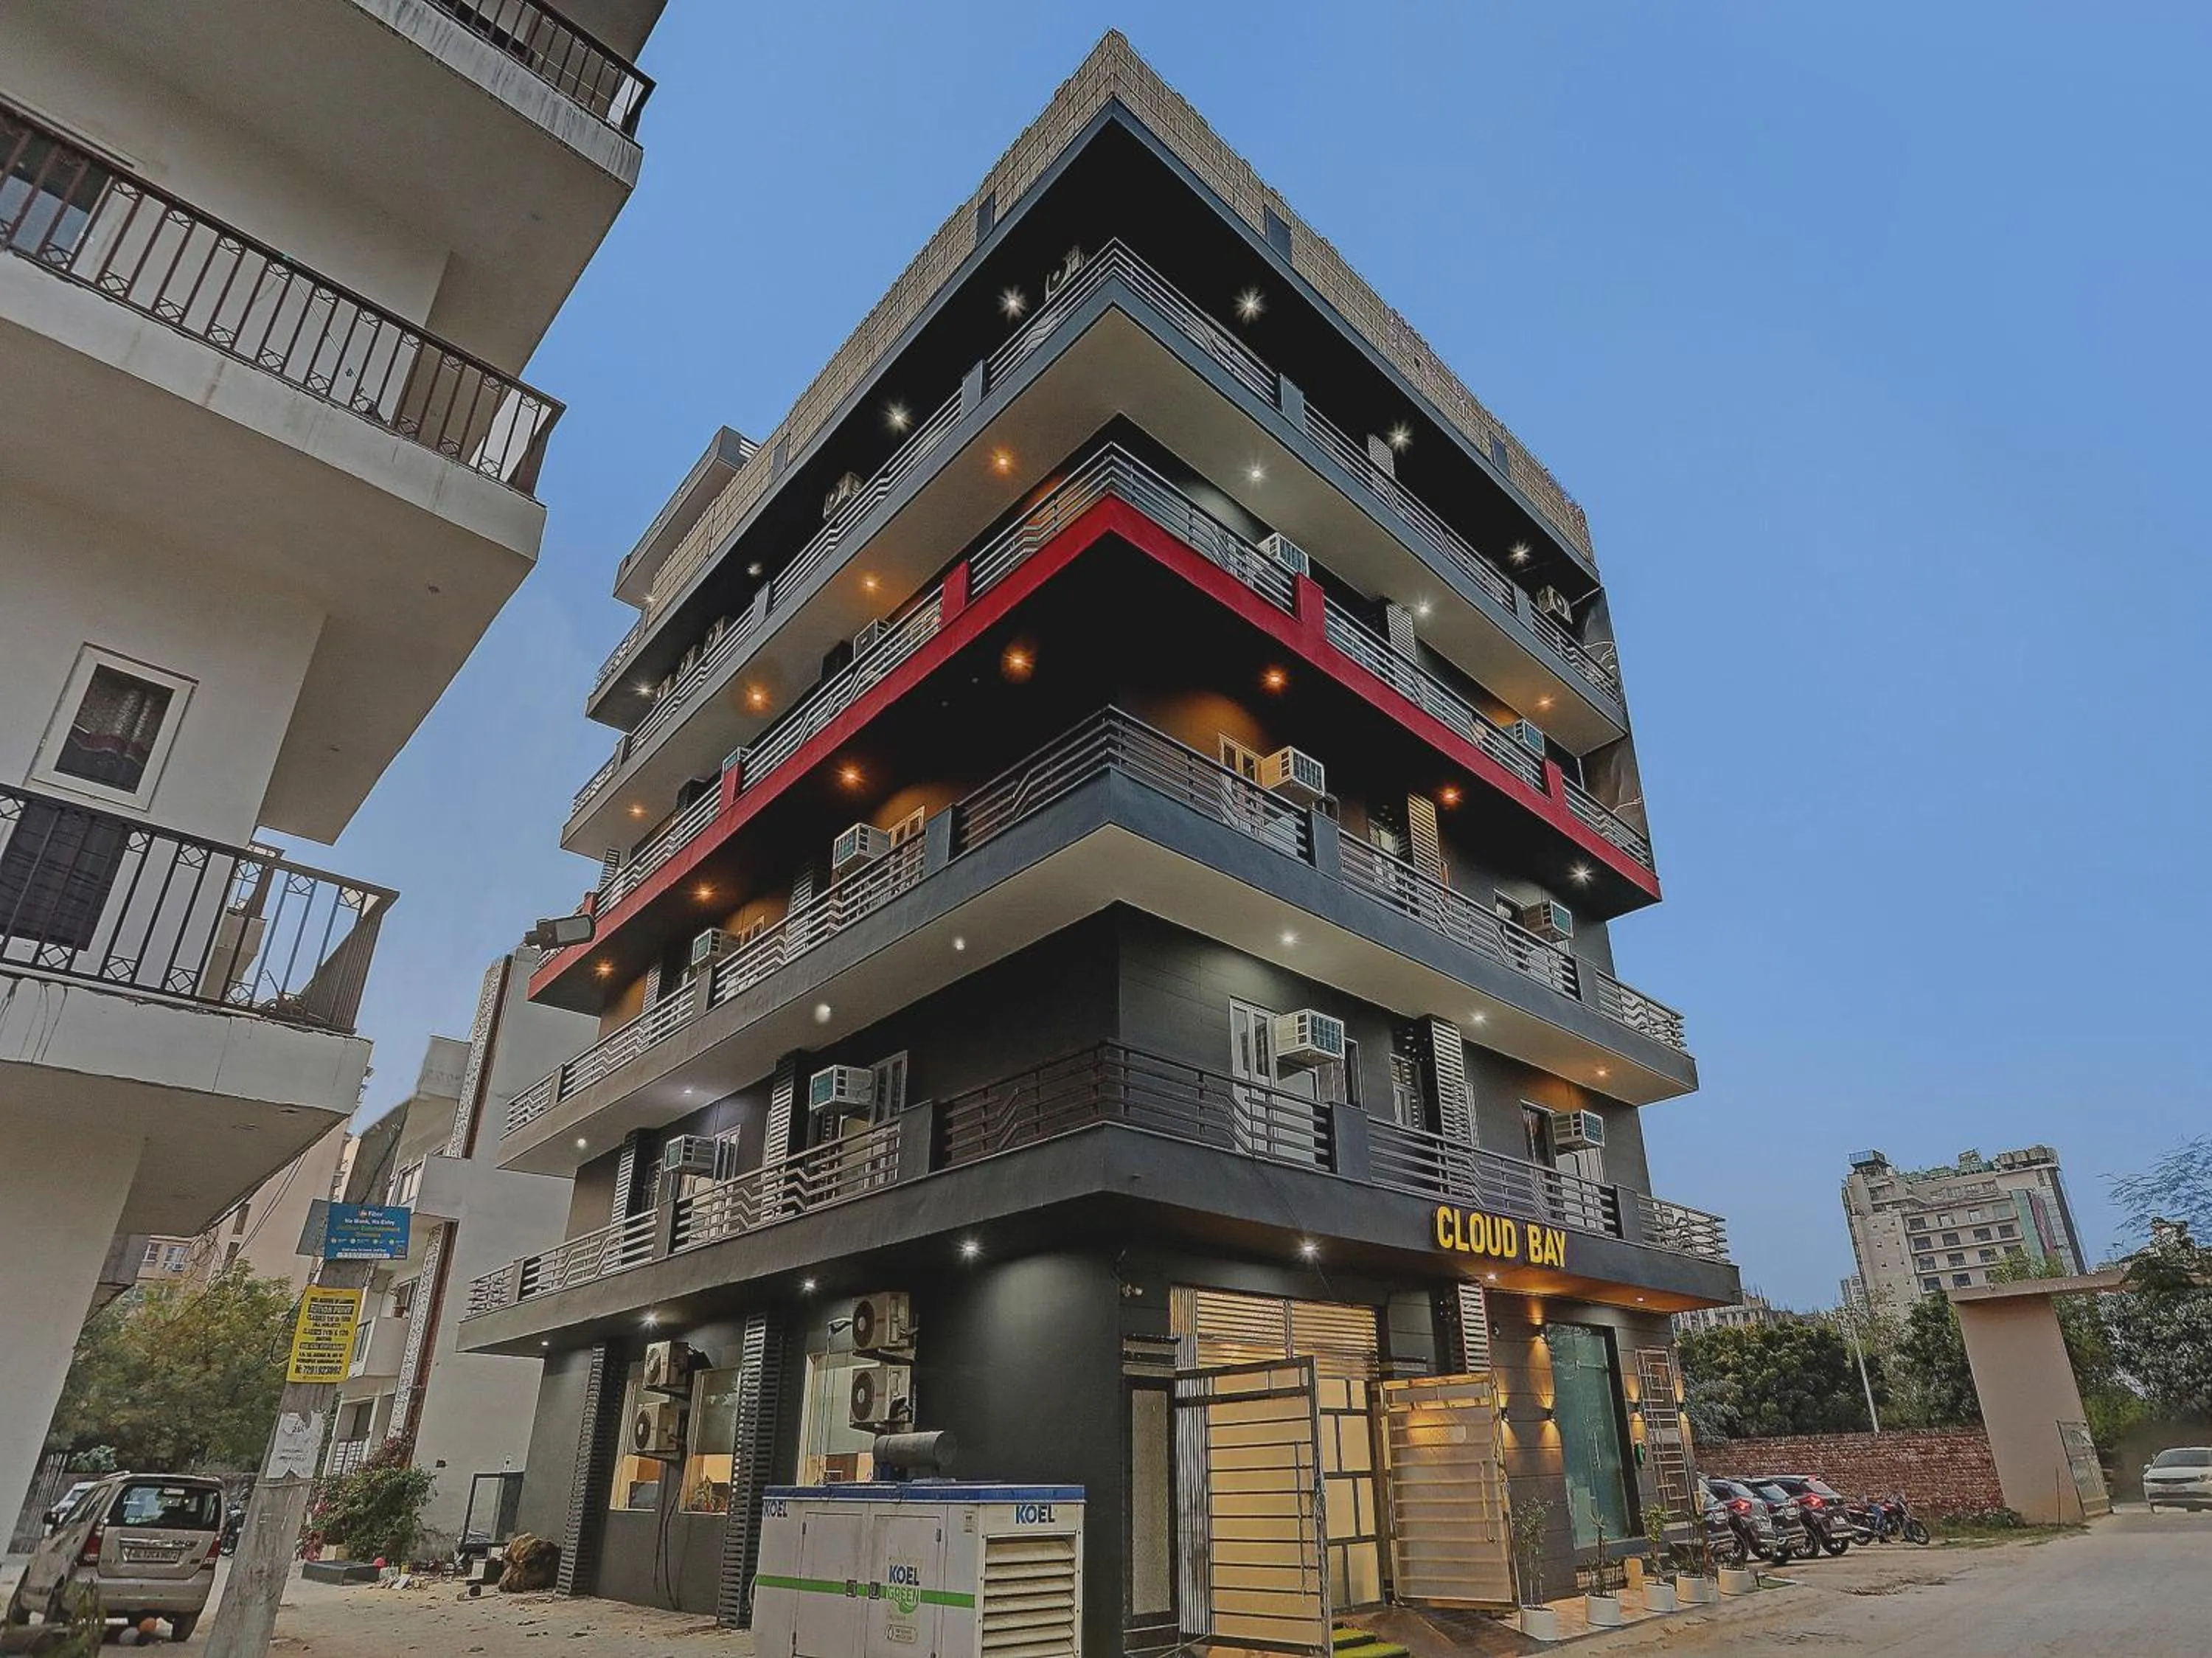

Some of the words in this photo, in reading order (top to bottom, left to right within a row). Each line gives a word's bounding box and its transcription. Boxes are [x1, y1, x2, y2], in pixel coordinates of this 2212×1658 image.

[1435, 1205, 1517, 1258] CLOUD
[1526, 1223, 1566, 1268] BAY
[763, 1499, 788, 1517] KOEL
[1015, 1505, 1055, 1524] KOEL
[888, 1564, 919, 1586] KOEL
